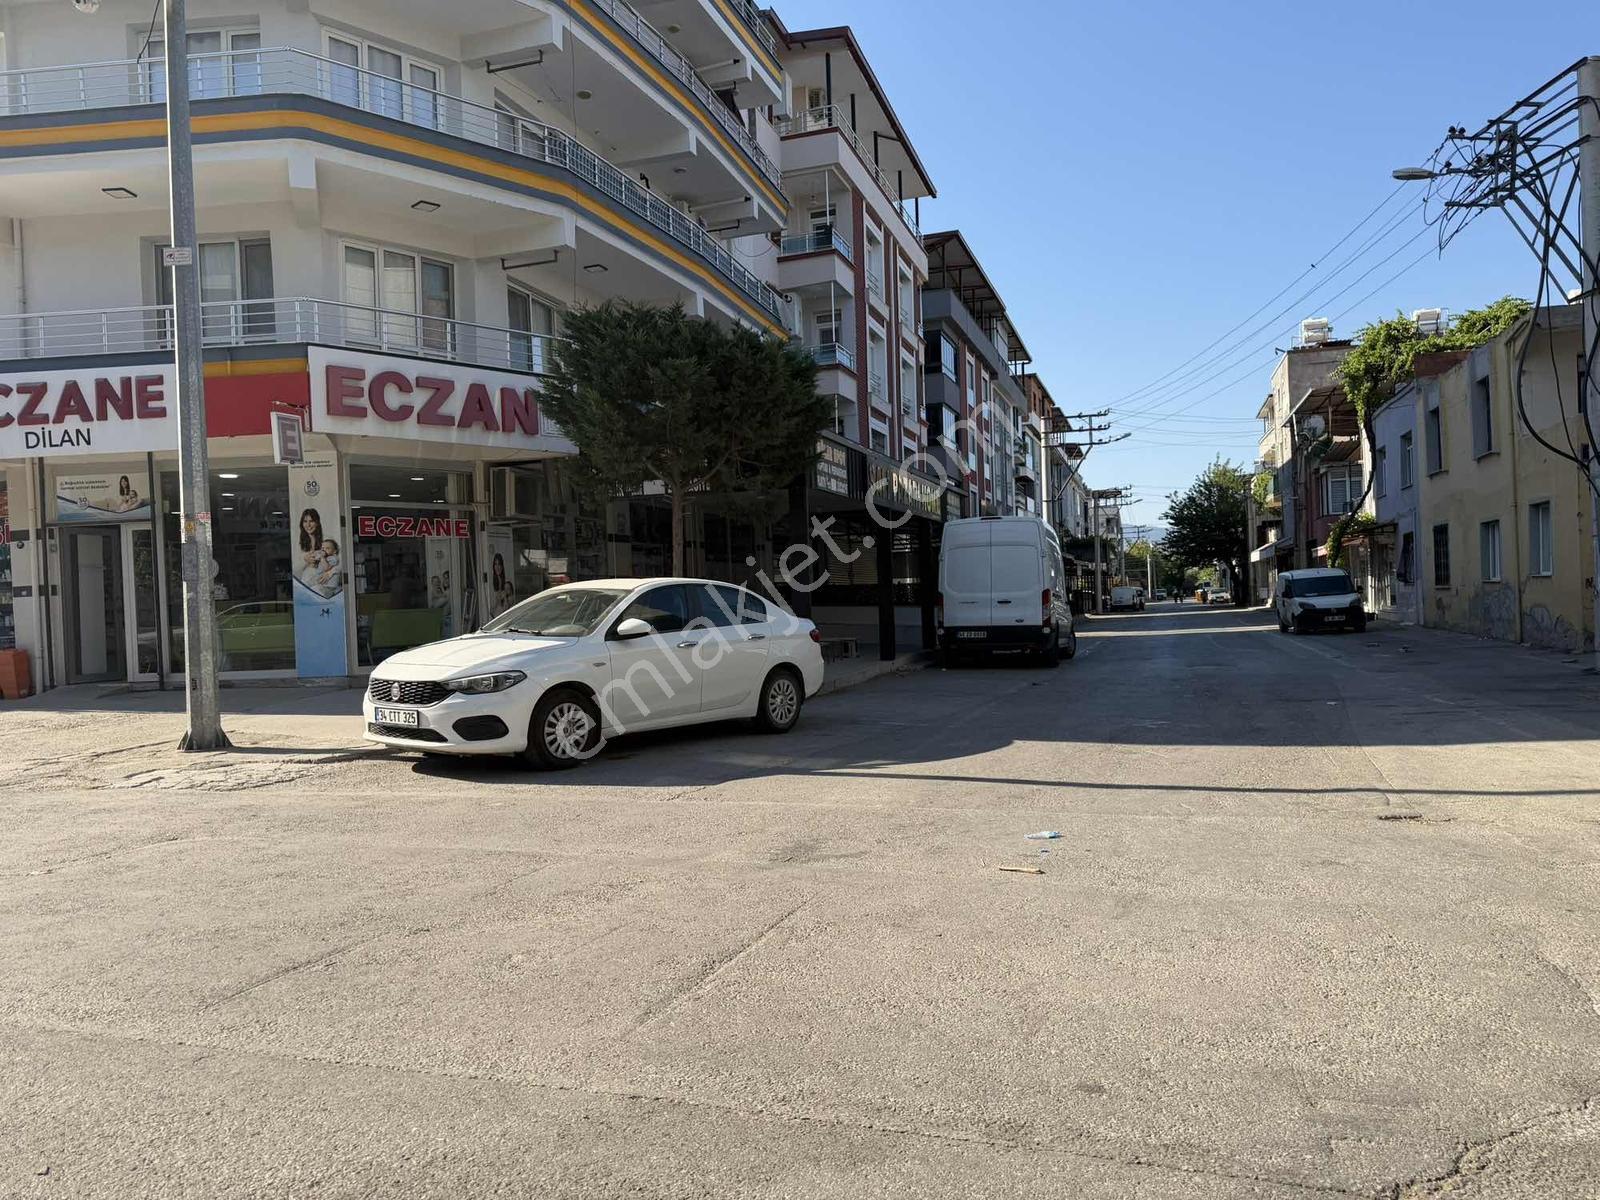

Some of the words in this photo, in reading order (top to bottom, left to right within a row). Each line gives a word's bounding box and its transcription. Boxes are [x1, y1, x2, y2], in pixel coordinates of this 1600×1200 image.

[325, 364, 552, 435] ECZAN
[25, 427, 92, 449] DİLAN
[280, 420, 299, 457] E
[358, 515, 470, 538] ECZANE
[379, 710, 387, 722] 34
[388, 711, 401, 723] CTT
[402, 712, 416, 724] 325
